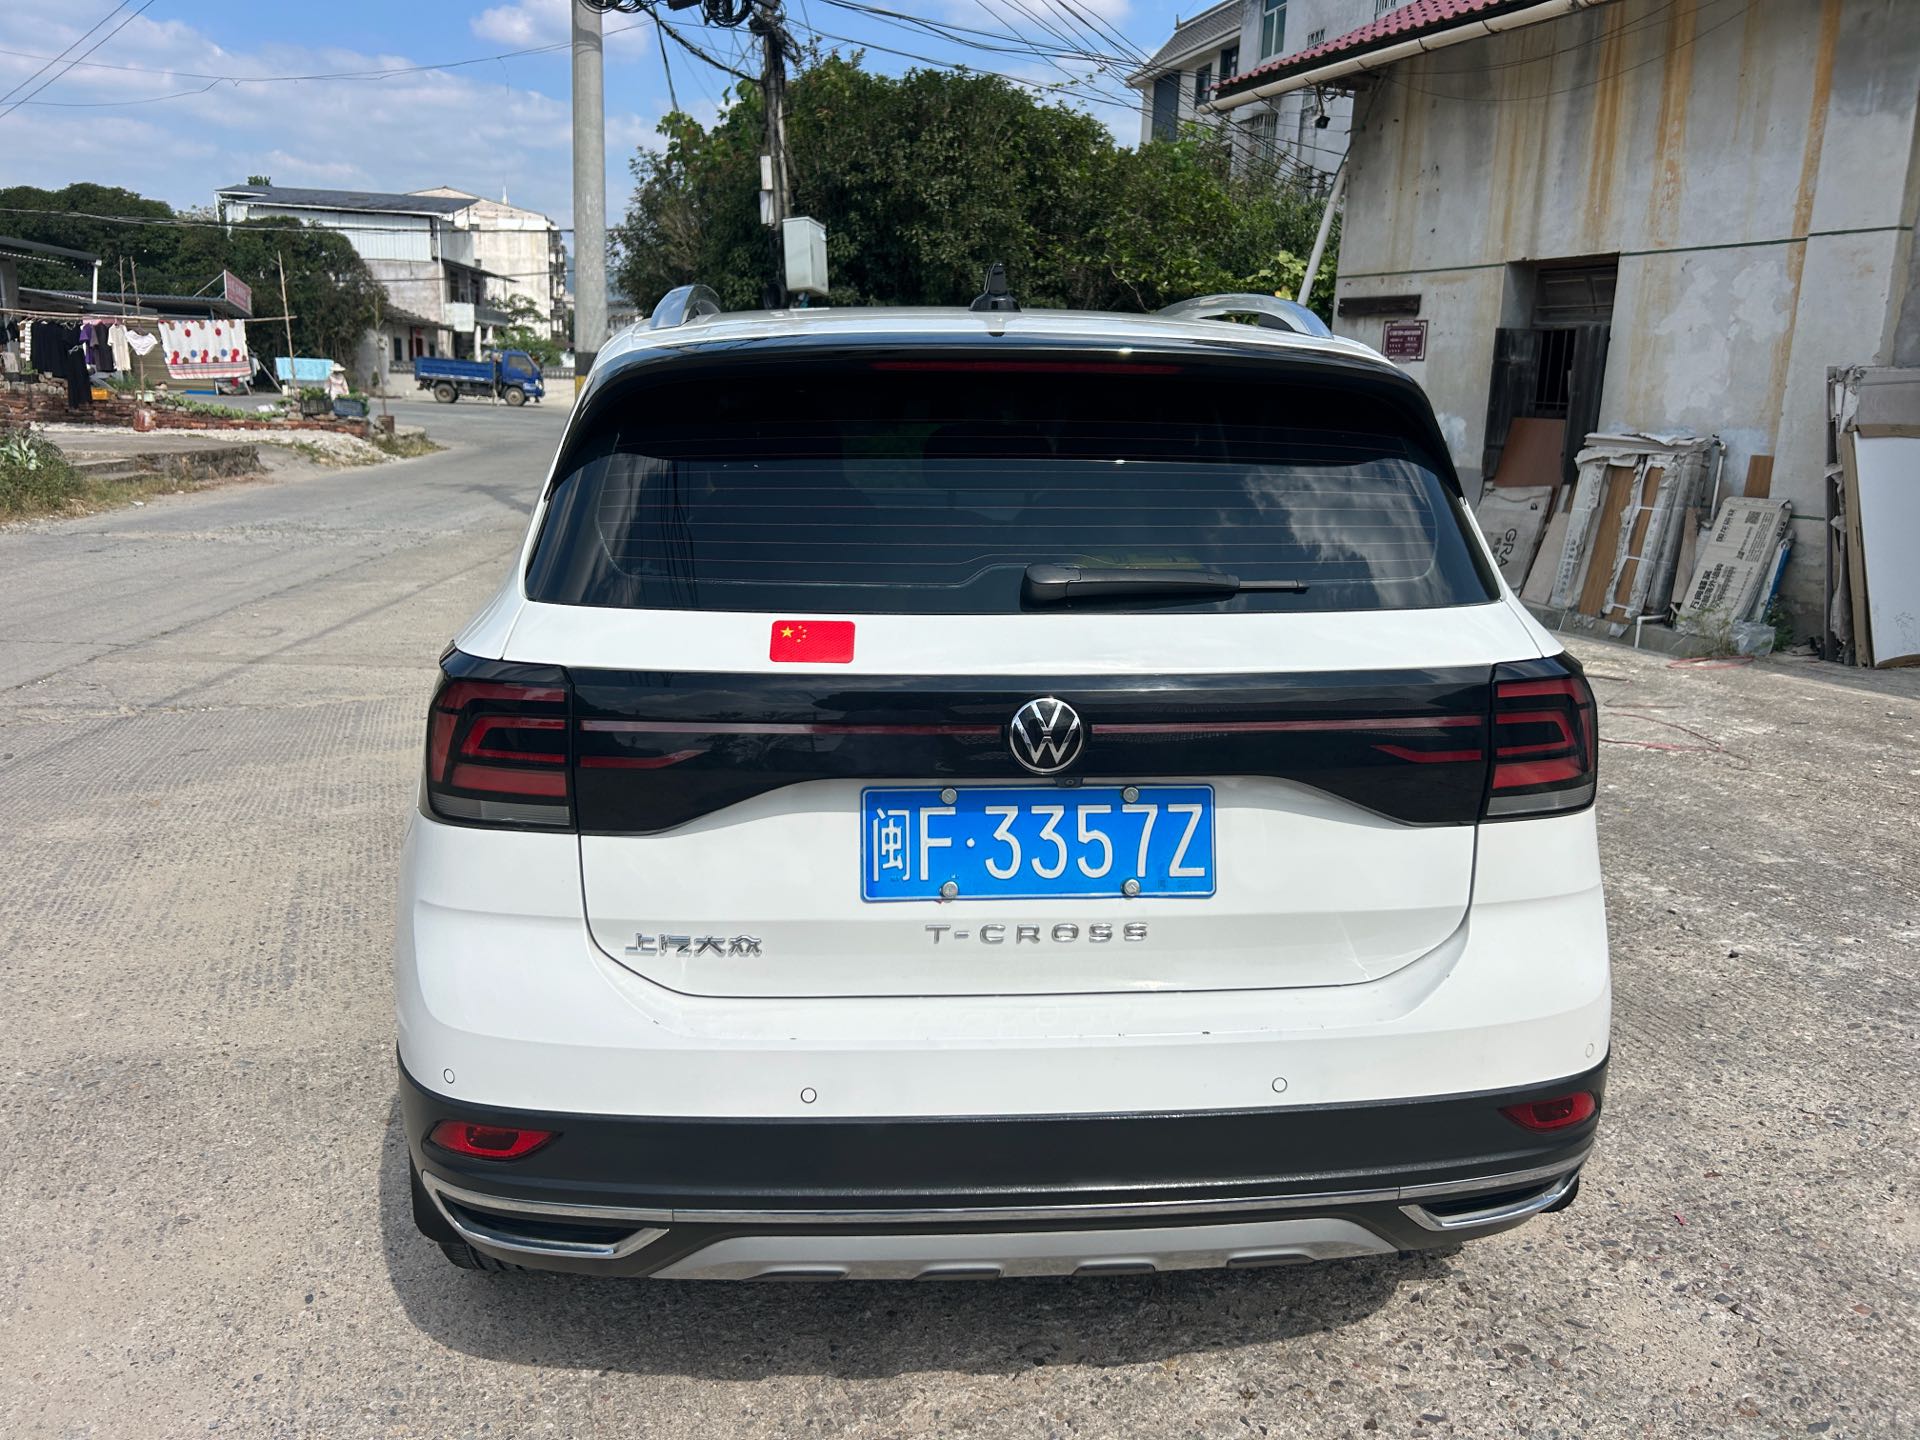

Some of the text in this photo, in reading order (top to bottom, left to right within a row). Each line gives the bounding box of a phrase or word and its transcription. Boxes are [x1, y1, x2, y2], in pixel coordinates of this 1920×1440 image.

[624, 932, 763, 957] 上汽大众
[925, 921, 1149, 945] T-CROSS
